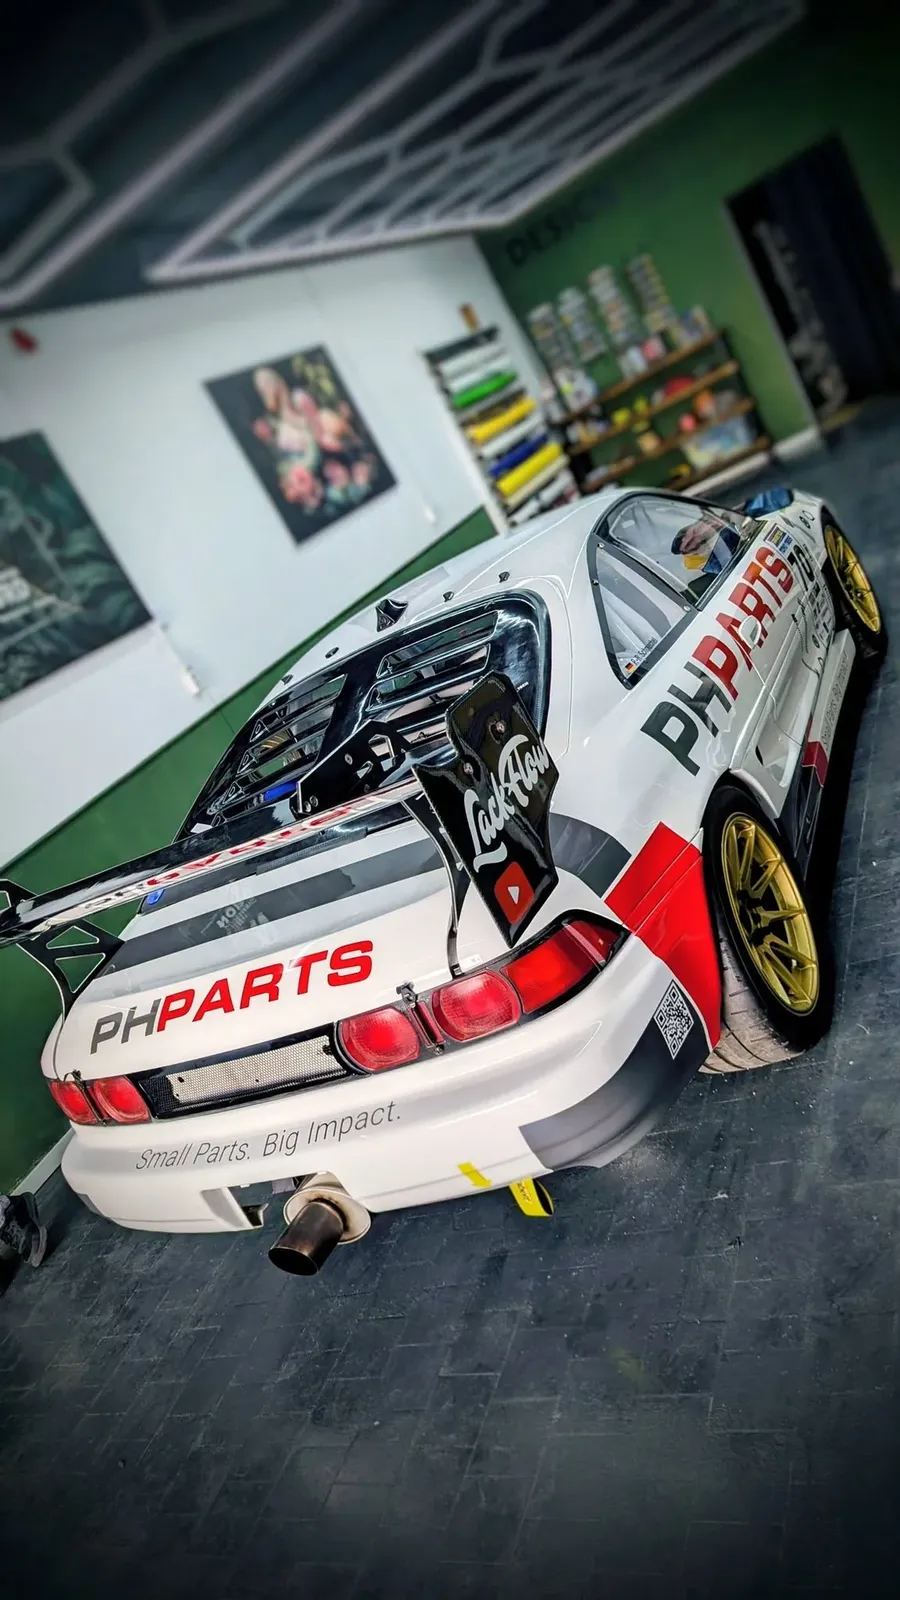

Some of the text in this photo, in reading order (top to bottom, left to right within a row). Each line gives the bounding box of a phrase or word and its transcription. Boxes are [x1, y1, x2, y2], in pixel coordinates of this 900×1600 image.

[787, 544, 815, 592] 70
[640, 546, 794, 777] PHPARTS
[90, 940, 374, 1055] PHPARTS
[136, 1100, 401, 1170] Small Parts. Big Impact.
